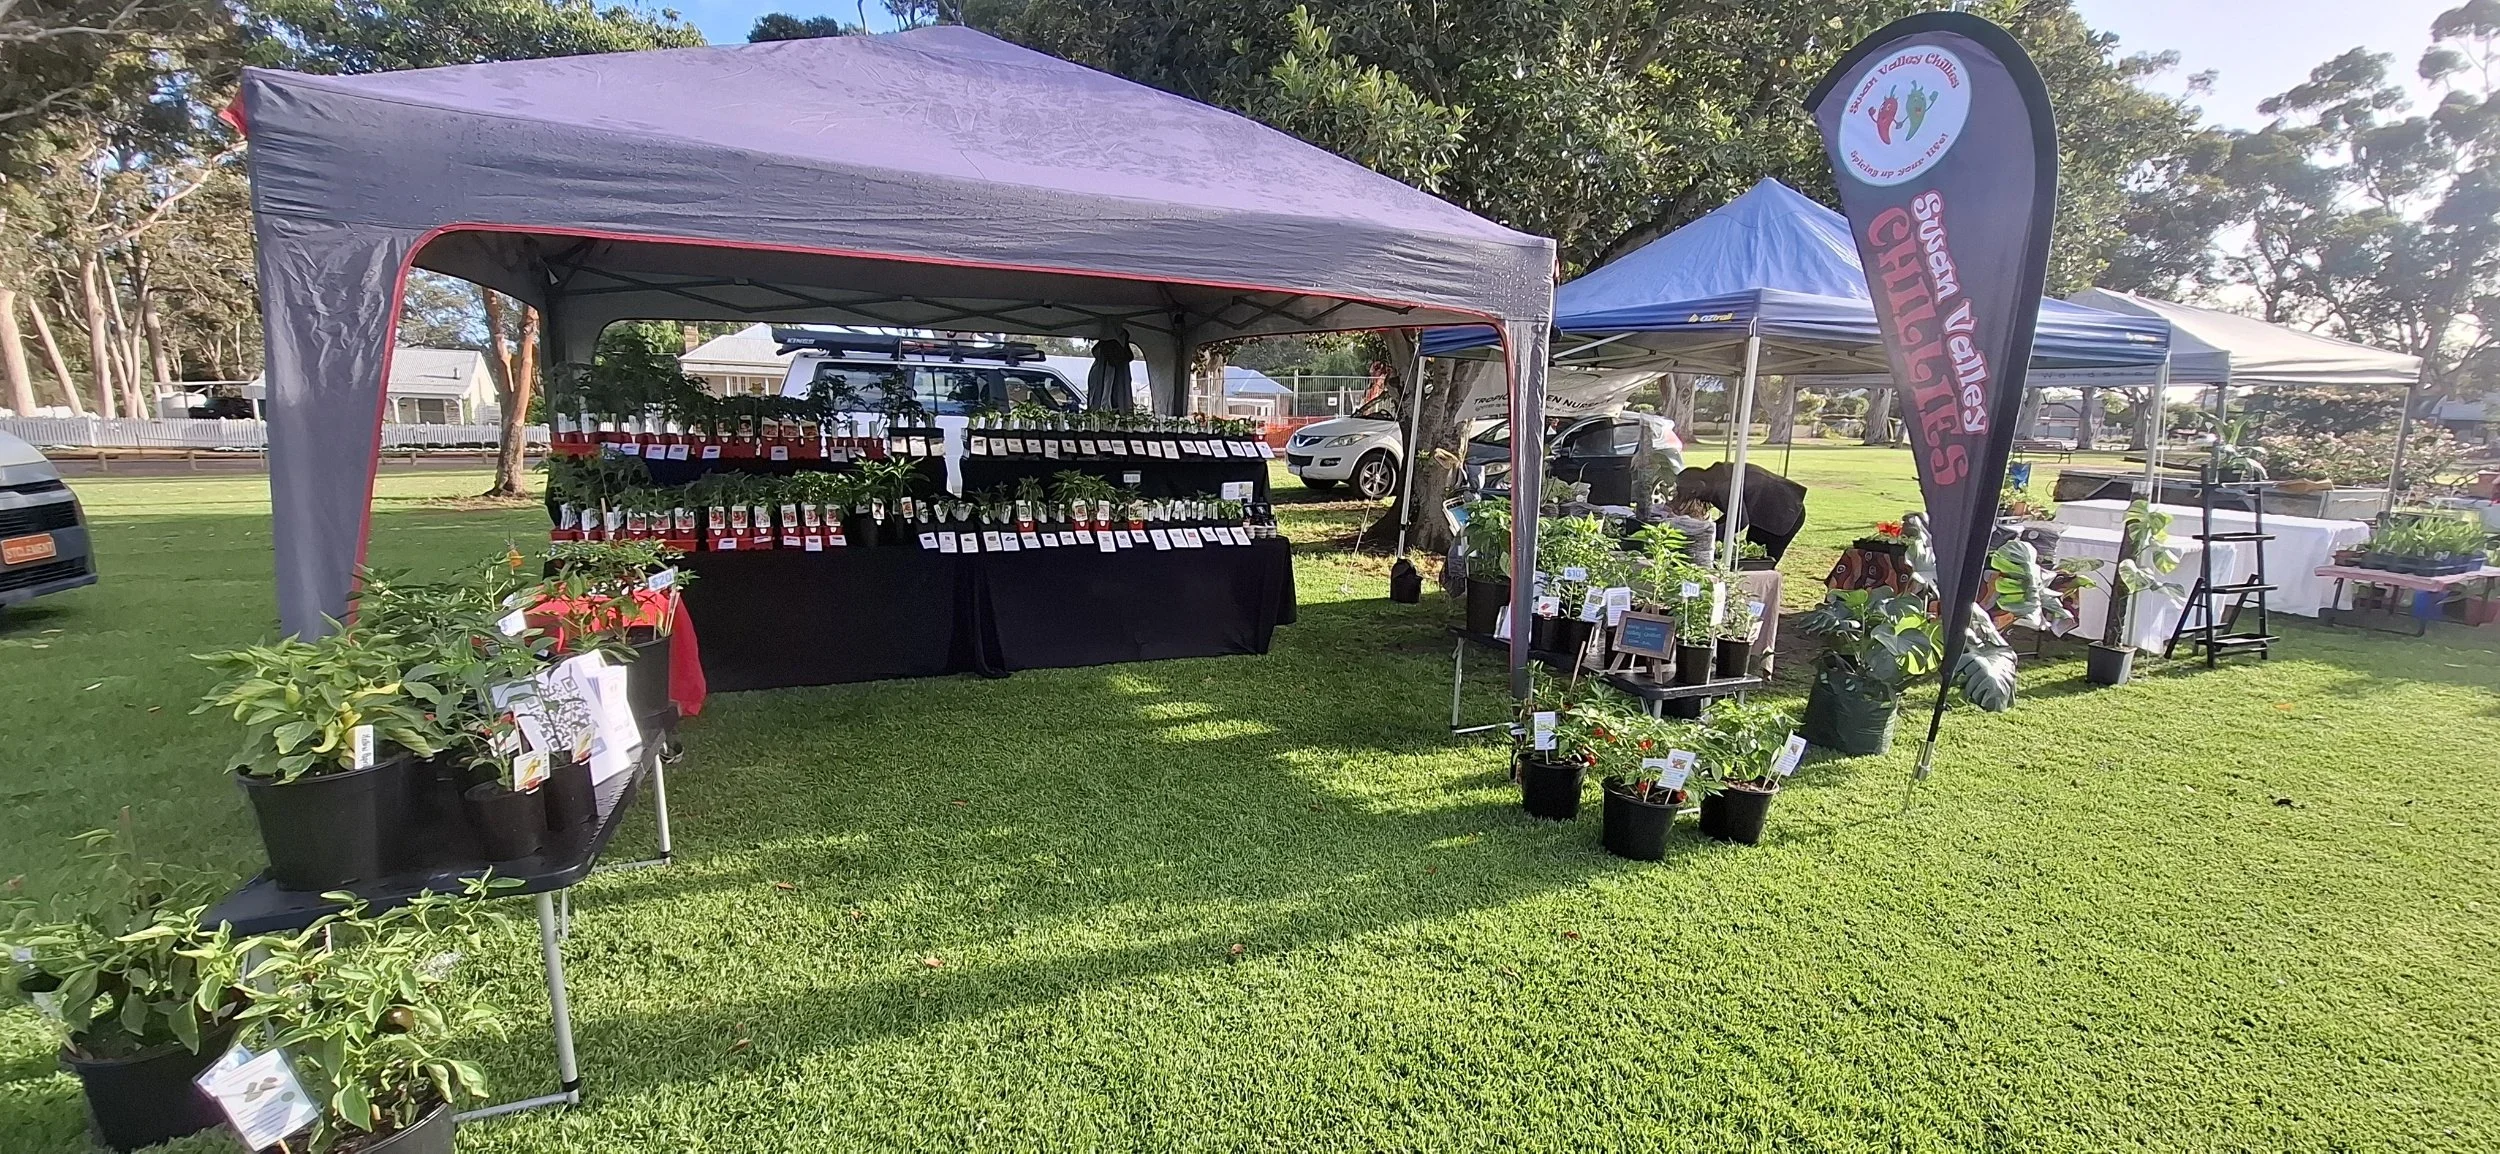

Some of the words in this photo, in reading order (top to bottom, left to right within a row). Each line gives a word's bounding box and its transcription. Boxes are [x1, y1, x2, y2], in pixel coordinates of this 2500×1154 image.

[1849, 76, 1878, 115] Swan
[1878, 55, 1922, 75] Valley
[1925, 52, 1960, 88] Chillies
[1850, 150, 1879, 178] Spicing
[1880, 171, 1895, 179] up
[1897, 158, 1924, 177] your
[1913, 190, 1959, 303] Swan
[1944, 299, 1989, 434] Valley
[786, 337, 816, 345] KINGS
[1867, 206, 1969, 486] CHILLIES
[1474, 392, 1509, 405] TROPIC
[651, 572, 672, 588] $20
[1566, 569, 1581, 578] $10
[1683, 582, 1697, 595] $10
